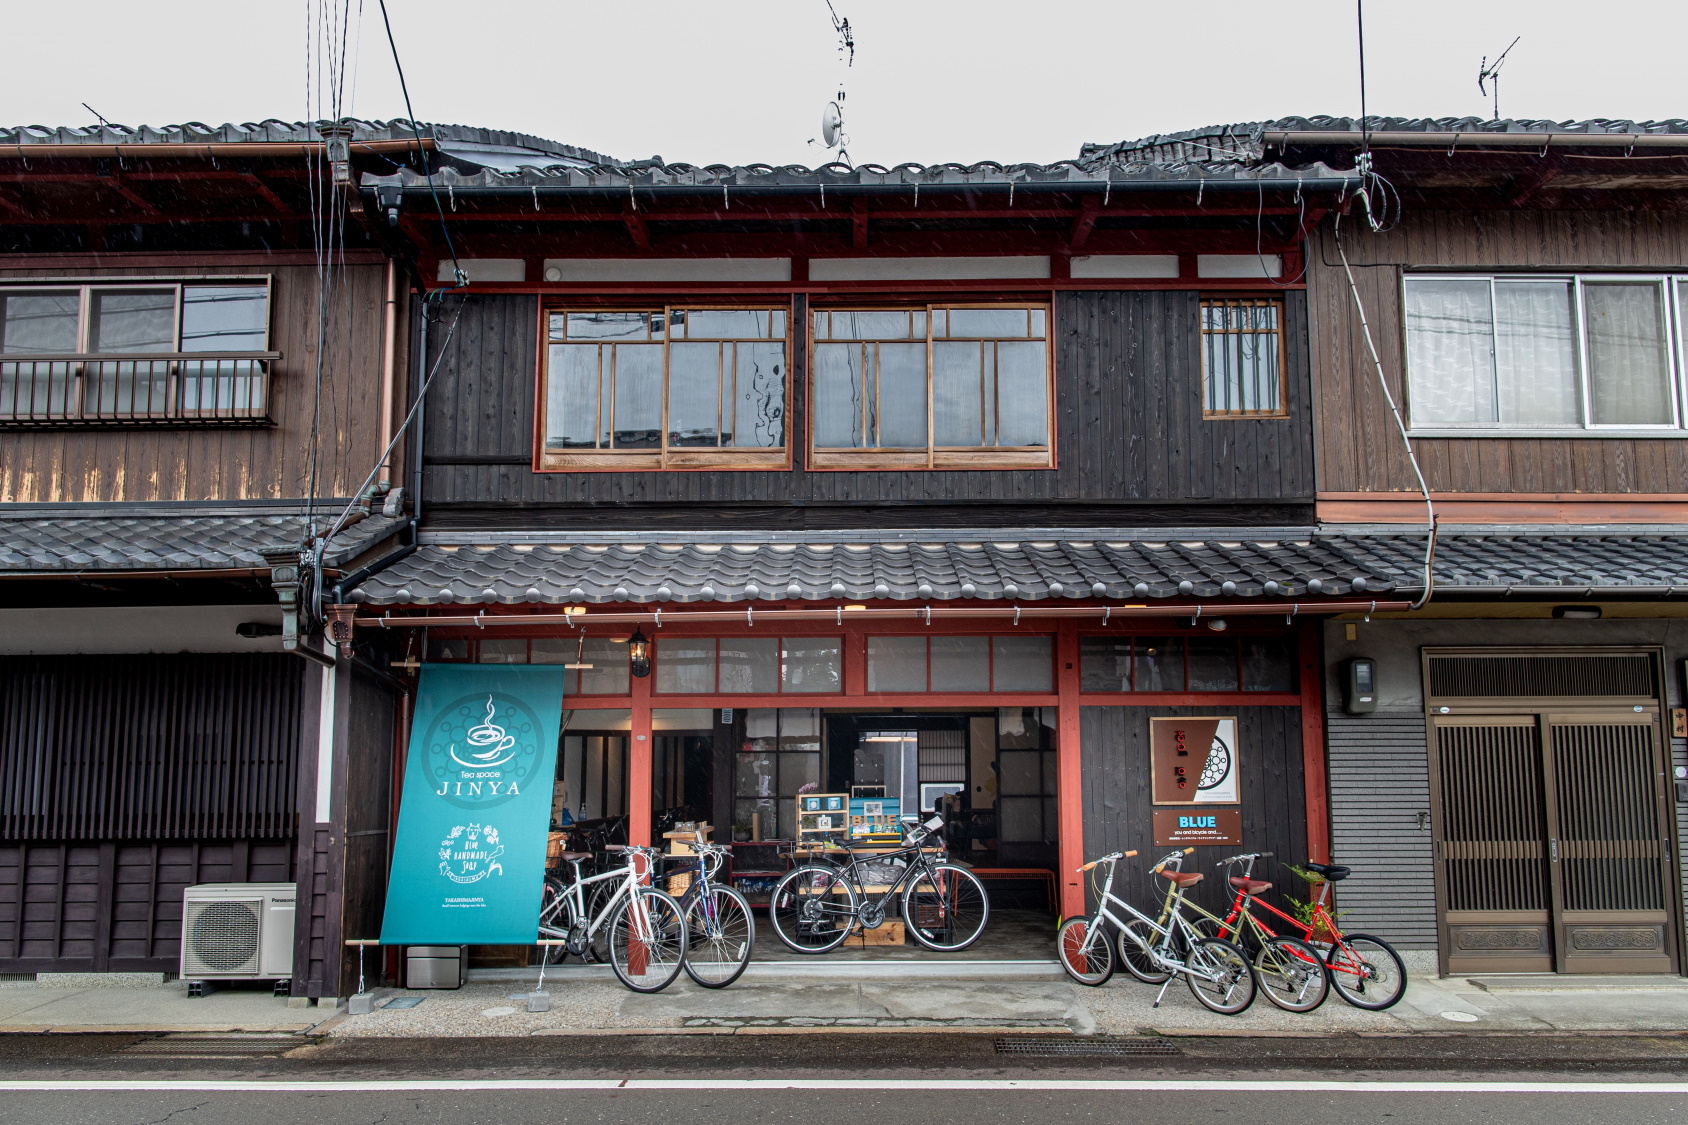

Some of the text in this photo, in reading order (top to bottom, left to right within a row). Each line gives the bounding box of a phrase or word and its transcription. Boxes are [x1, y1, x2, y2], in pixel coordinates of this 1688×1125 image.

[1675, 711, 1684, 733] 中村
[461, 771, 500, 779] Tea space
[436, 781, 520, 795] JINYA
[852, 815, 896, 825] BLUE
[1179, 816, 1216, 828] BLUE
[454, 851, 488, 860] HANDMADE
